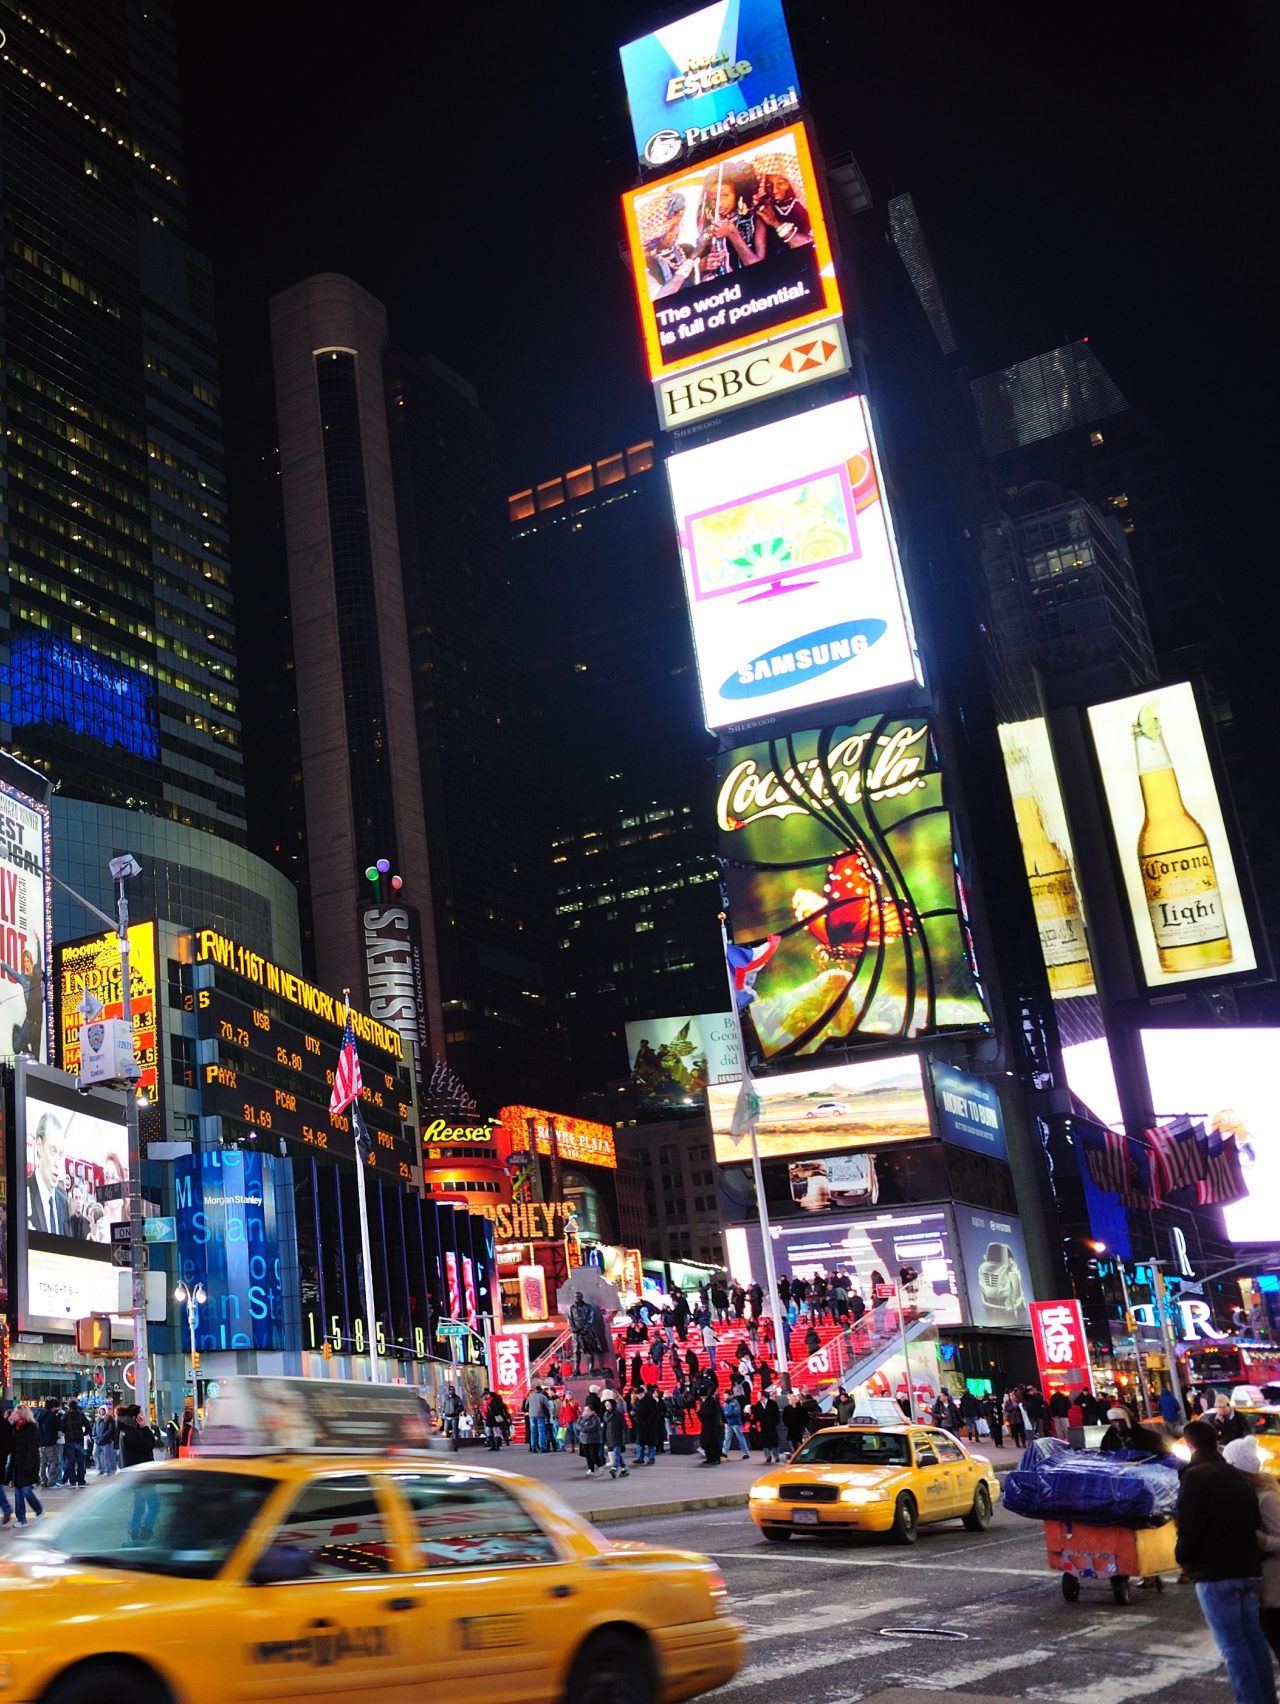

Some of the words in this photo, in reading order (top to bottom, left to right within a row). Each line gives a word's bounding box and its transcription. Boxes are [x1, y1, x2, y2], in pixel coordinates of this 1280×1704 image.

[665, 59, 753, 102] Estate
[684, 85, 800, 147] Prudential
[655, 306, 692, 326] The
[693, 283, 742, 313] world
[659, 331, 676, 346] is
[677, 317, 705, 340] full
[708, 309, 728, 329] of
[728, 281, 811, 325] potential.
[665, 357, 775, 417] HSBC
[673, 418, 722, 440] SHERWOOD
[737, 633, 870, 685] SAMSUNG
[727, 716, 776, 734] SHERWOOD
[1146, 854, 1212, 882] Corona
[1158, 900, 1216, 929] Light
[266, 961, 281, 994] IN
[280, 969, 336, 1024] NETWORK
[363, 908, 423, 1083] RSHEY'S
[413, 946, 425, 1014] Chocolate
[220, 1020, 250, 1048] 70.73
[253, 1009, 270, 1032] USB
[305, 1035, 321, 1056] UTX
[384, 1074, 394, 1091] VZ
[720, 1053, 739, 1066] did
[206, 1065, 237, 1089] PAYX
[275, 1089, 297, 1112] PCAR
[330, 1112, 349, 1133] PDCO
[942, 1090, 968, 1119] MONEY
[968, 1099, 980, 1123] TO
[980, 1103, 999, 1130] BURN
[243, 1103, 273, 1130] 31.69
[302, 1125, 328, 1149] 54.82
[423, 1118, 494, 1143] Reese's
[578, 1134, 612, 1154] PLAZA
[204, 1195, 234, 1206] Morgan
[234, 1194, 263, 1207] Stanley
[145, 1224, 165, 1236] WAY
[1041, 1305, 1075, 1364] tkts
[497, 1338, 520, 1387] tkts
